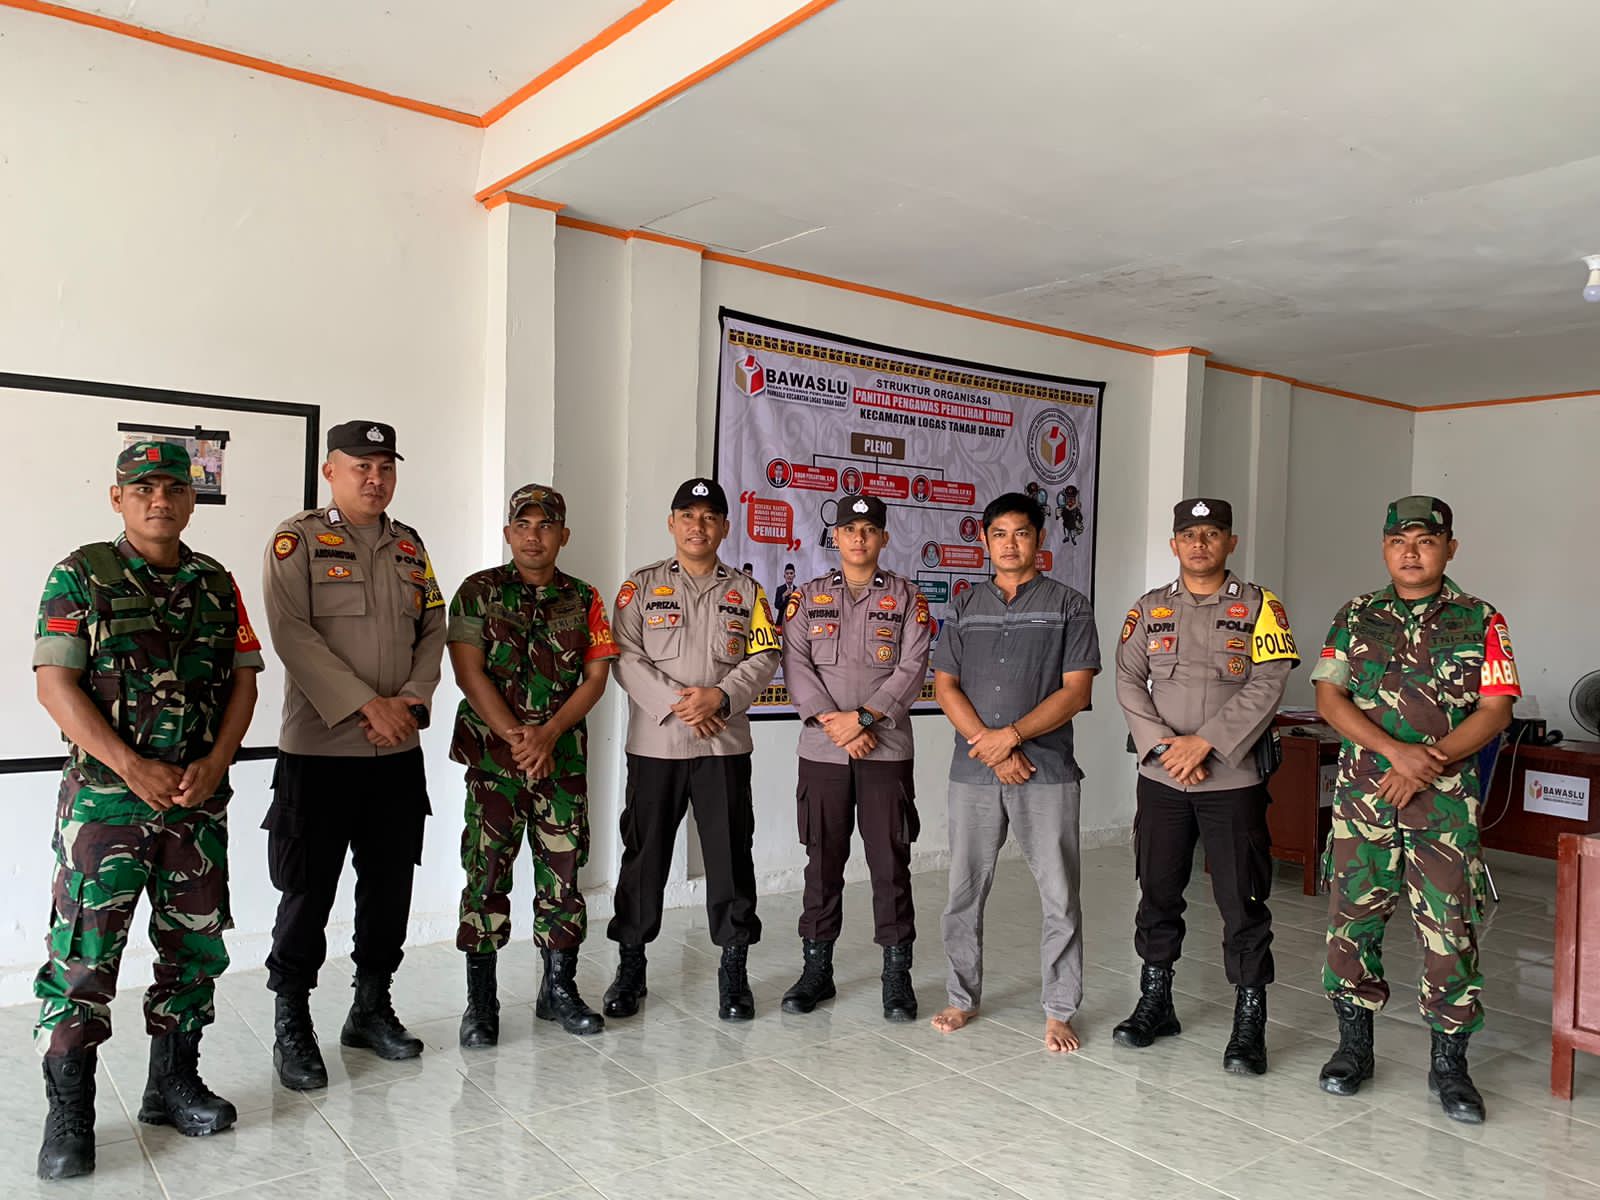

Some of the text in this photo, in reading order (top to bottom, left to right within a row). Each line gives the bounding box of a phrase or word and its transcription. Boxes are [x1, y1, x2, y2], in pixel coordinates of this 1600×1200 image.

[766, 369, 848, 395] BAWASLU
[876, 379, 991, 405] STRUKTUR ORGANISASI
[855, 390, 1011, 424] PANITIA PENGAWAS PEMILIHAN UMUM
[860, 408, 1006, 439] KECAMATAN LOGAS TANAH DARAT
[864, 439, 893, 455] PLENO
[753, 525, 787, 538] PEMILU
[645, 601, 681, 611] APRIZAL
[868, 611, 902, 623] POLRI
[1147, 622, 1175, 634] ADRI
[1543, 786, 1585, 800] BAWASLU
